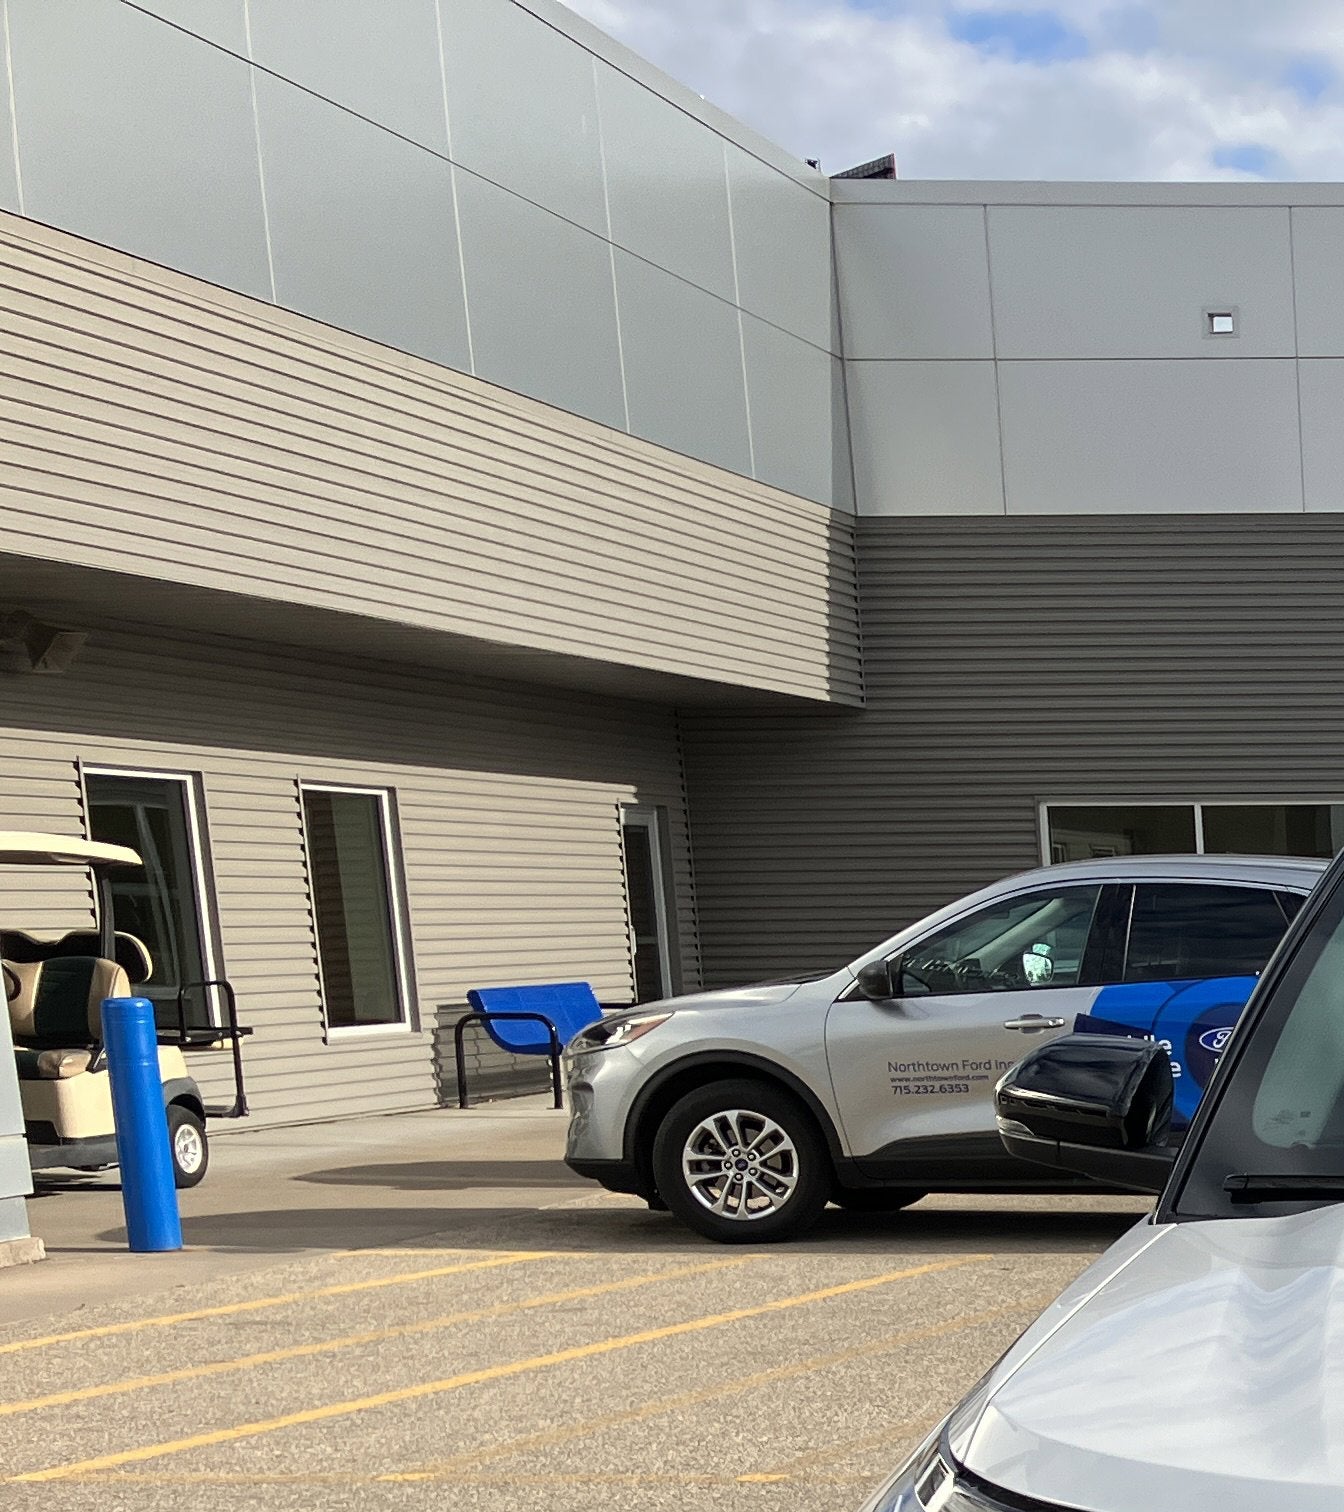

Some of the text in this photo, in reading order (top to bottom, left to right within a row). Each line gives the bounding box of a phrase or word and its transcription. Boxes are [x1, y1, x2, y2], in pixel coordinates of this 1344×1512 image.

[888, 1061, 959, 1072] Northtown
[962, 1060, 992, 1071] Ford
[891, 1084, 970, 1095] 715.232.6353
